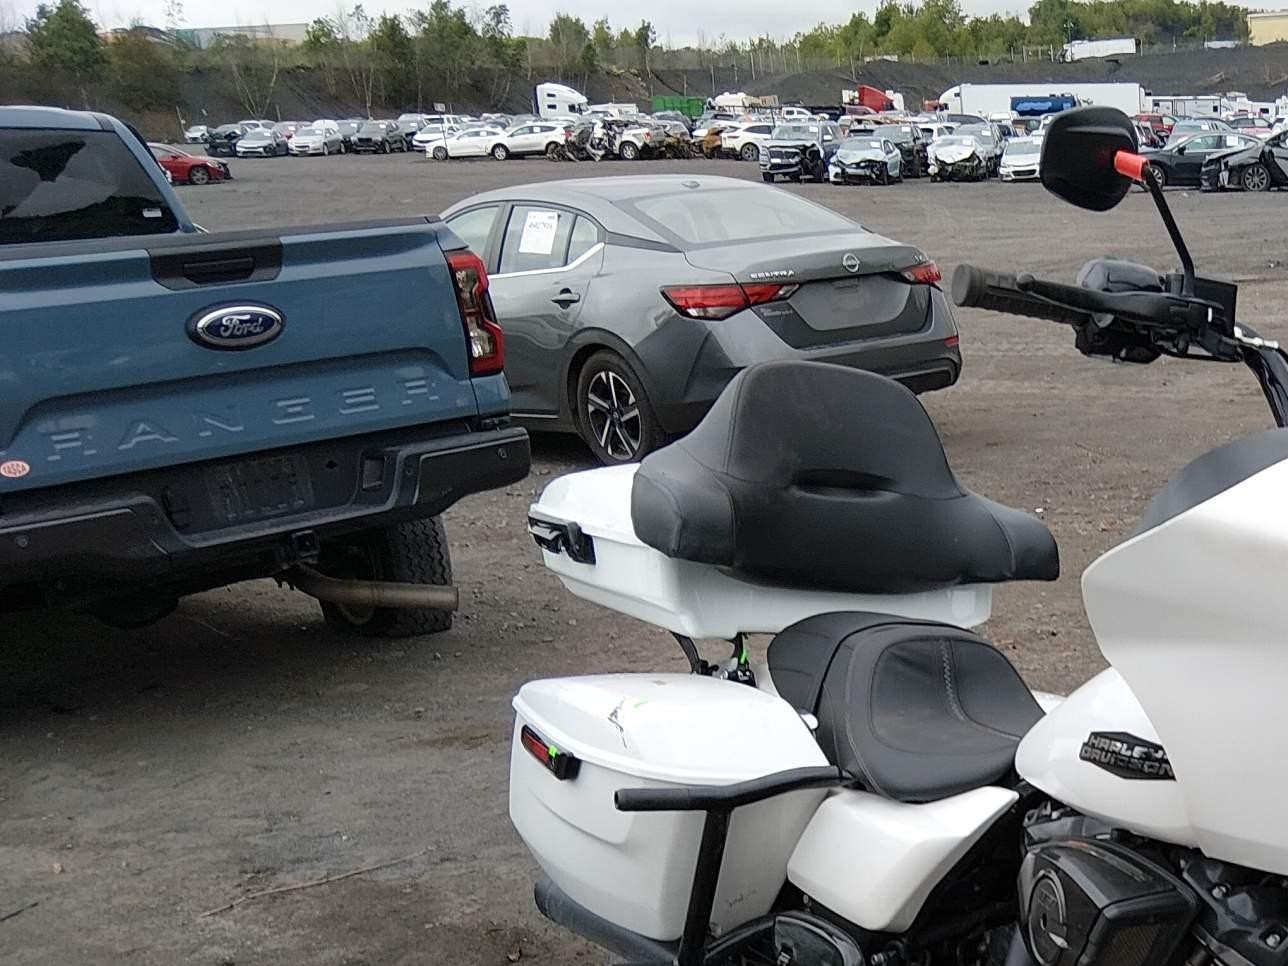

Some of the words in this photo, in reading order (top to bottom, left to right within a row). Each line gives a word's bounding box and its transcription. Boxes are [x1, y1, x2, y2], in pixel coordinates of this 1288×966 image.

[751, 270, 795, 279] SENTRA
[220, 314, 264, 337] Ford
[46, 379, 440, 462] RANGER
